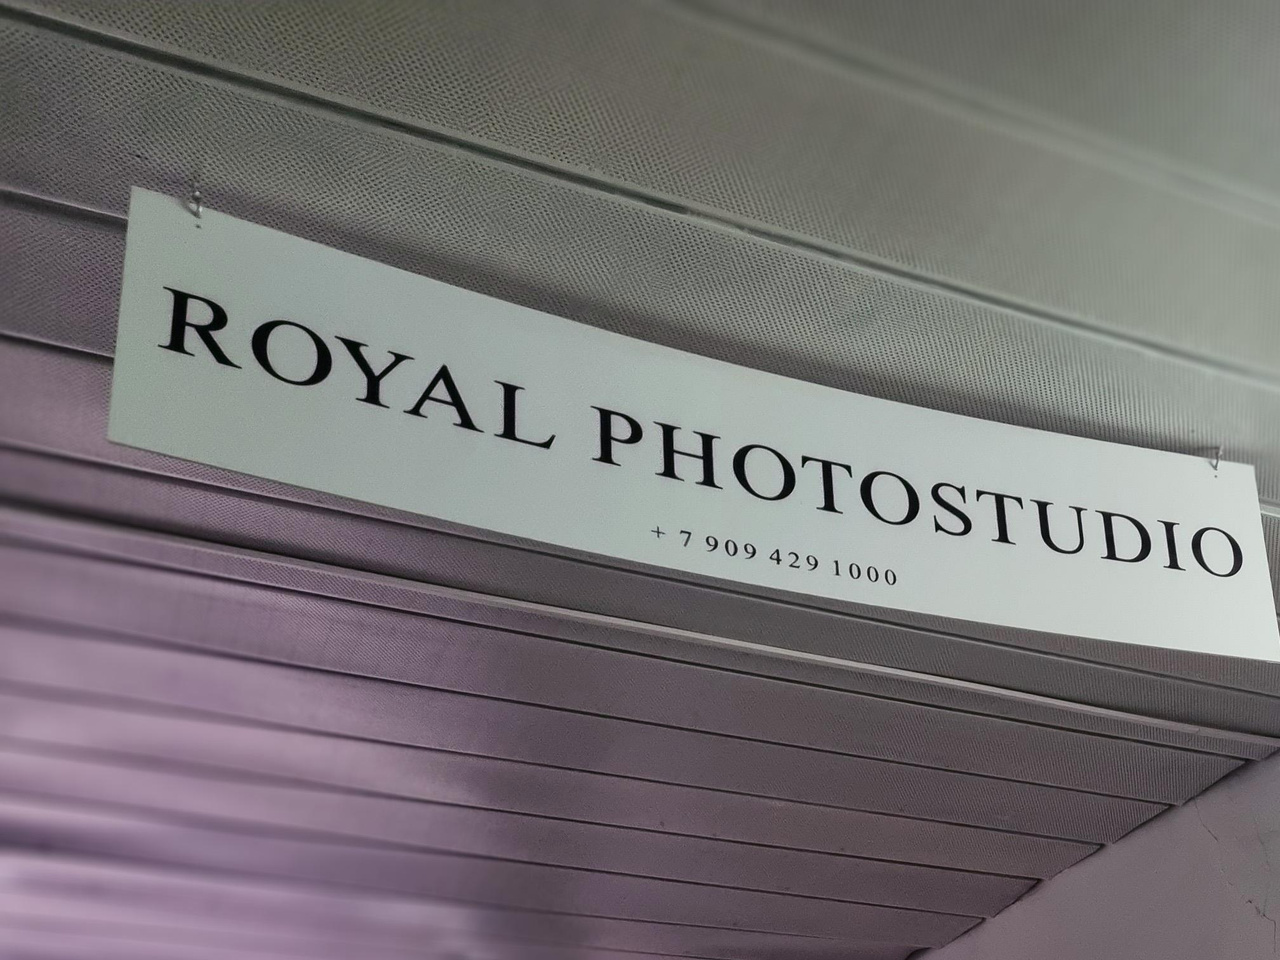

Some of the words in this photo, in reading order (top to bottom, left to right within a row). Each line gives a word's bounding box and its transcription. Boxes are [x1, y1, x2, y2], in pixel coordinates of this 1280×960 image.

[156, 284, 557, 451] ROYAL
[589, 404, 1245, 580] PHOTOSTUDIO
[679, 529, 693, 548] 7
[705, 535, 757, 560] 909
[768, 548, 819, 572] 429
[832, 559, 898, 586] 1000
